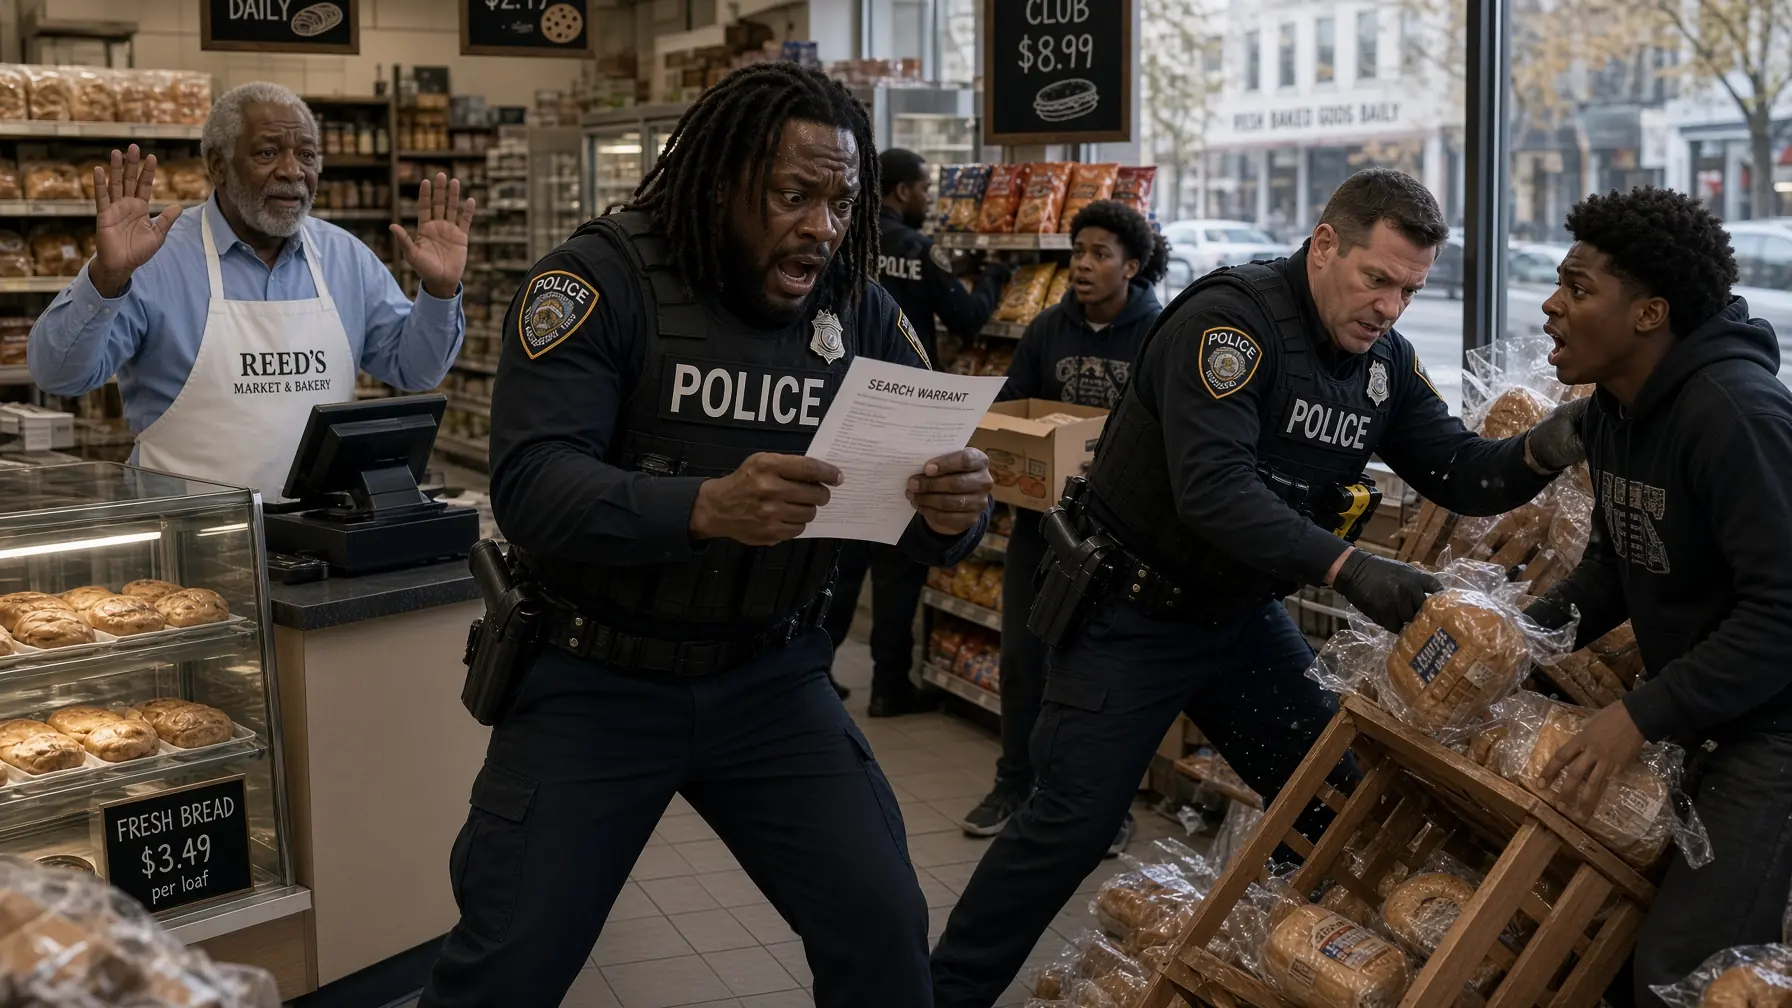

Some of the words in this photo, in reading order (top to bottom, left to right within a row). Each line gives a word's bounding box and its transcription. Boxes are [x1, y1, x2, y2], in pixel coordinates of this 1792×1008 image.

[229, 0, 291, 21] DAILY
[1026, 0, 1089, 25] CLUB
[1018, 33, 1093, 74] $8.99
[534, 277, 589, 304] POLICE
[1208, 332, 1257, 360] POLICE
[240, 350, 326, 376] REED'S
[234, 382, 281, 394] MARKET
[284, 381, 292, 392] &
[295, 379, 331, 392] BAKERY
[670, 363, 824, 426] POLICE
[868, 379, 915, 397] SEARCH
[917, 387, 969, 403] WARRANT
[1286, 398, 1371, 450] POLICE
[117, 809, 173, 842] FRESH
[180, 797, 234, 827] BREAD
[141, 834, 211, 879] $3.49
[152, 882, 176, 904] per
[181, 869, 209, 892] loaf
